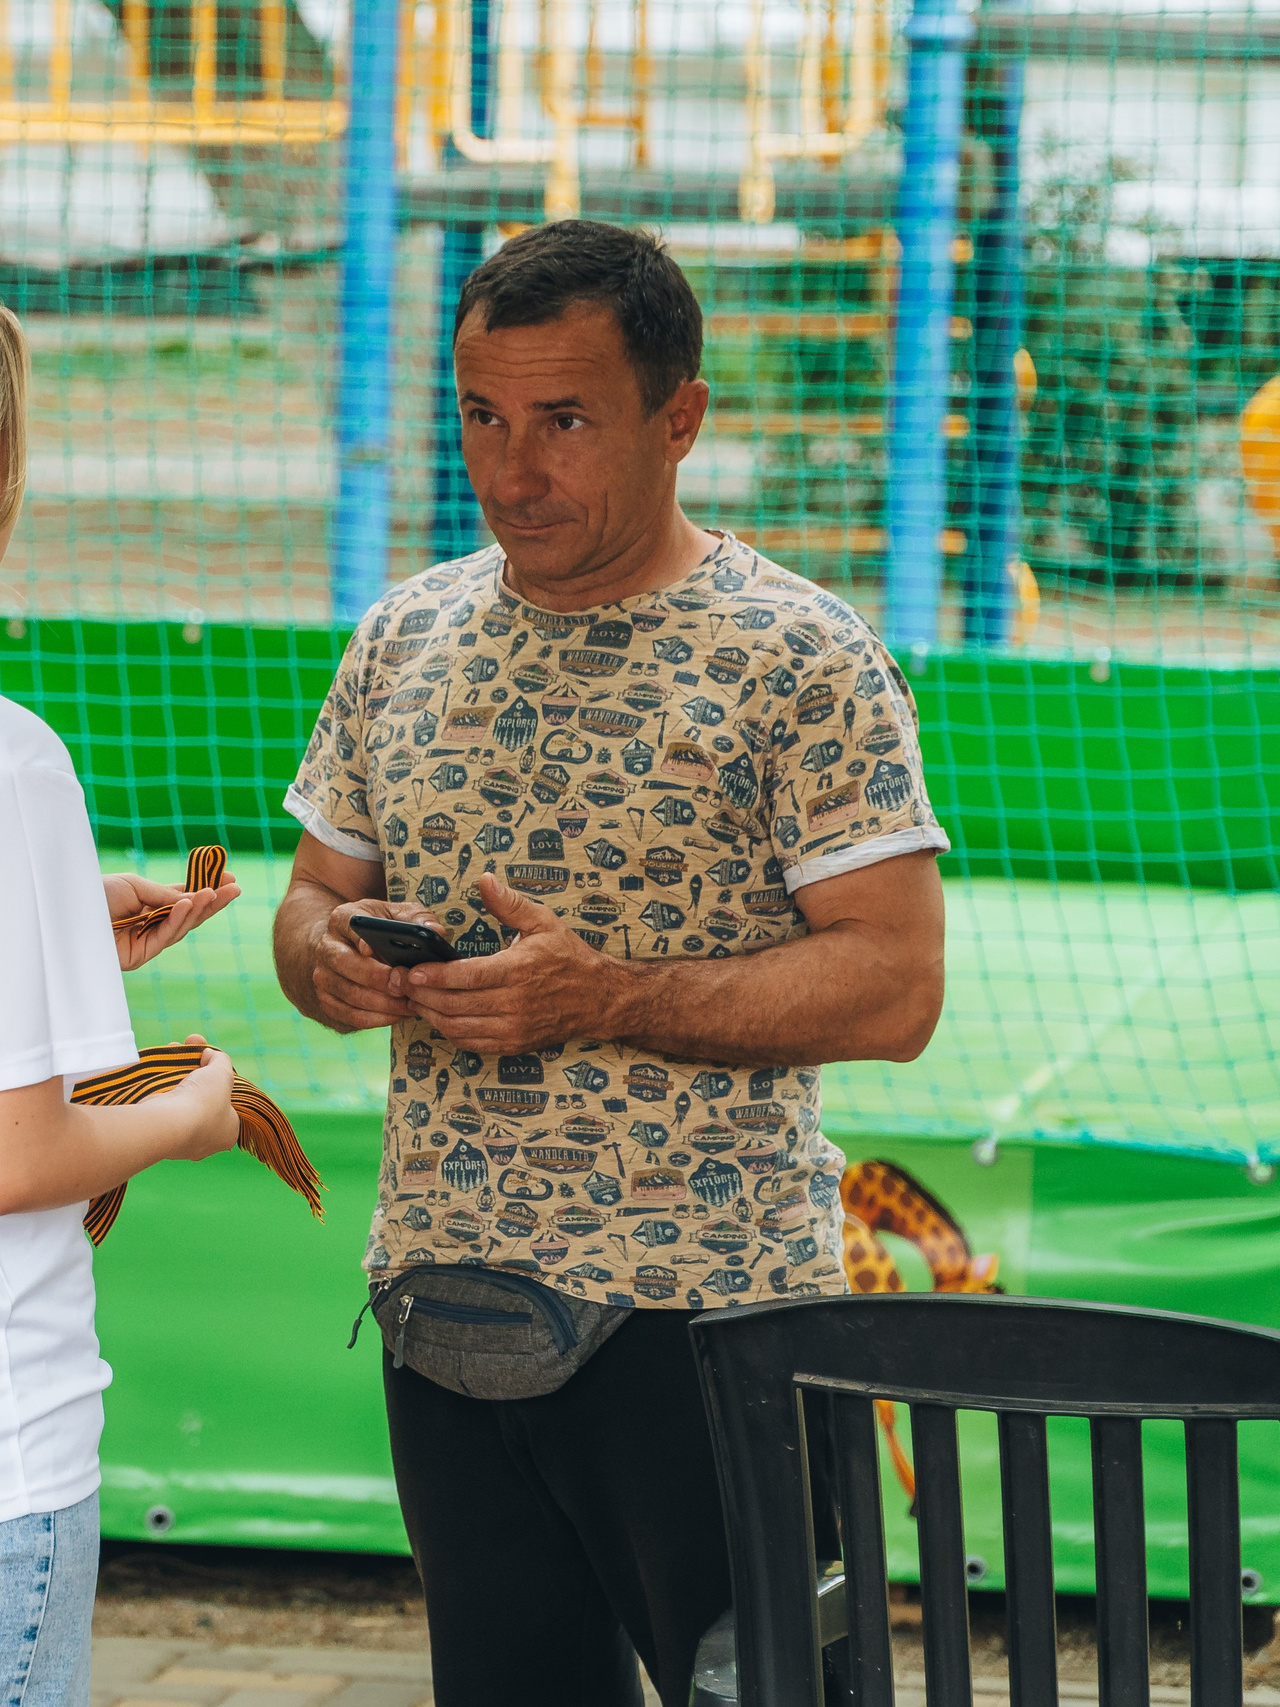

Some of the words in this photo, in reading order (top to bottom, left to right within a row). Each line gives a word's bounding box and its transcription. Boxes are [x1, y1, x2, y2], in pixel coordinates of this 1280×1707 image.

[527, 609, 567, 626] WANDER
[591, 630, 629, 641] LOVE
[566, 651, 600, 665] WANDER
[603, 655, 620, 667] LTD
[627, 692, 663, 700] CAMPING
[497, 718, 537, 729] EXPLORER
[585, 710, 620, 725] WANDER
[622, 714, 638, 728] LTD
[865, 733, 899, 744] CAMPING
[483, 780, 519, 793] CAMPING
[586, 784, 625, 793] CAMPING
[867, 775, 910, 795] EXPLORER
[710, 822, 740, 835] CANG
[531, 842, 561, 850] LOVE
[644, 861, 684, 870] JOURNEY
[514, 867, 548, 880] WANDER
[550, 869, 564, 881] LTD
[502, 1067, 540, 1075] LOVE
[484, 1090, 521, 1103] WANDER
[524, 1093, 541, 1104] LTD
[450, 1114, 481, 1123] CAMPING
[530, 1149, 568, 1161] WANDER
[573, 1151, 590, 1162] LTD
[443, 1160, 487, 1171] EXPLORER
[689, 1172, 740, 1189] EXPLORER
[446, 1220, 480, 1231] CAMPING
[702, 1232, 748, 1240] CAMPING
